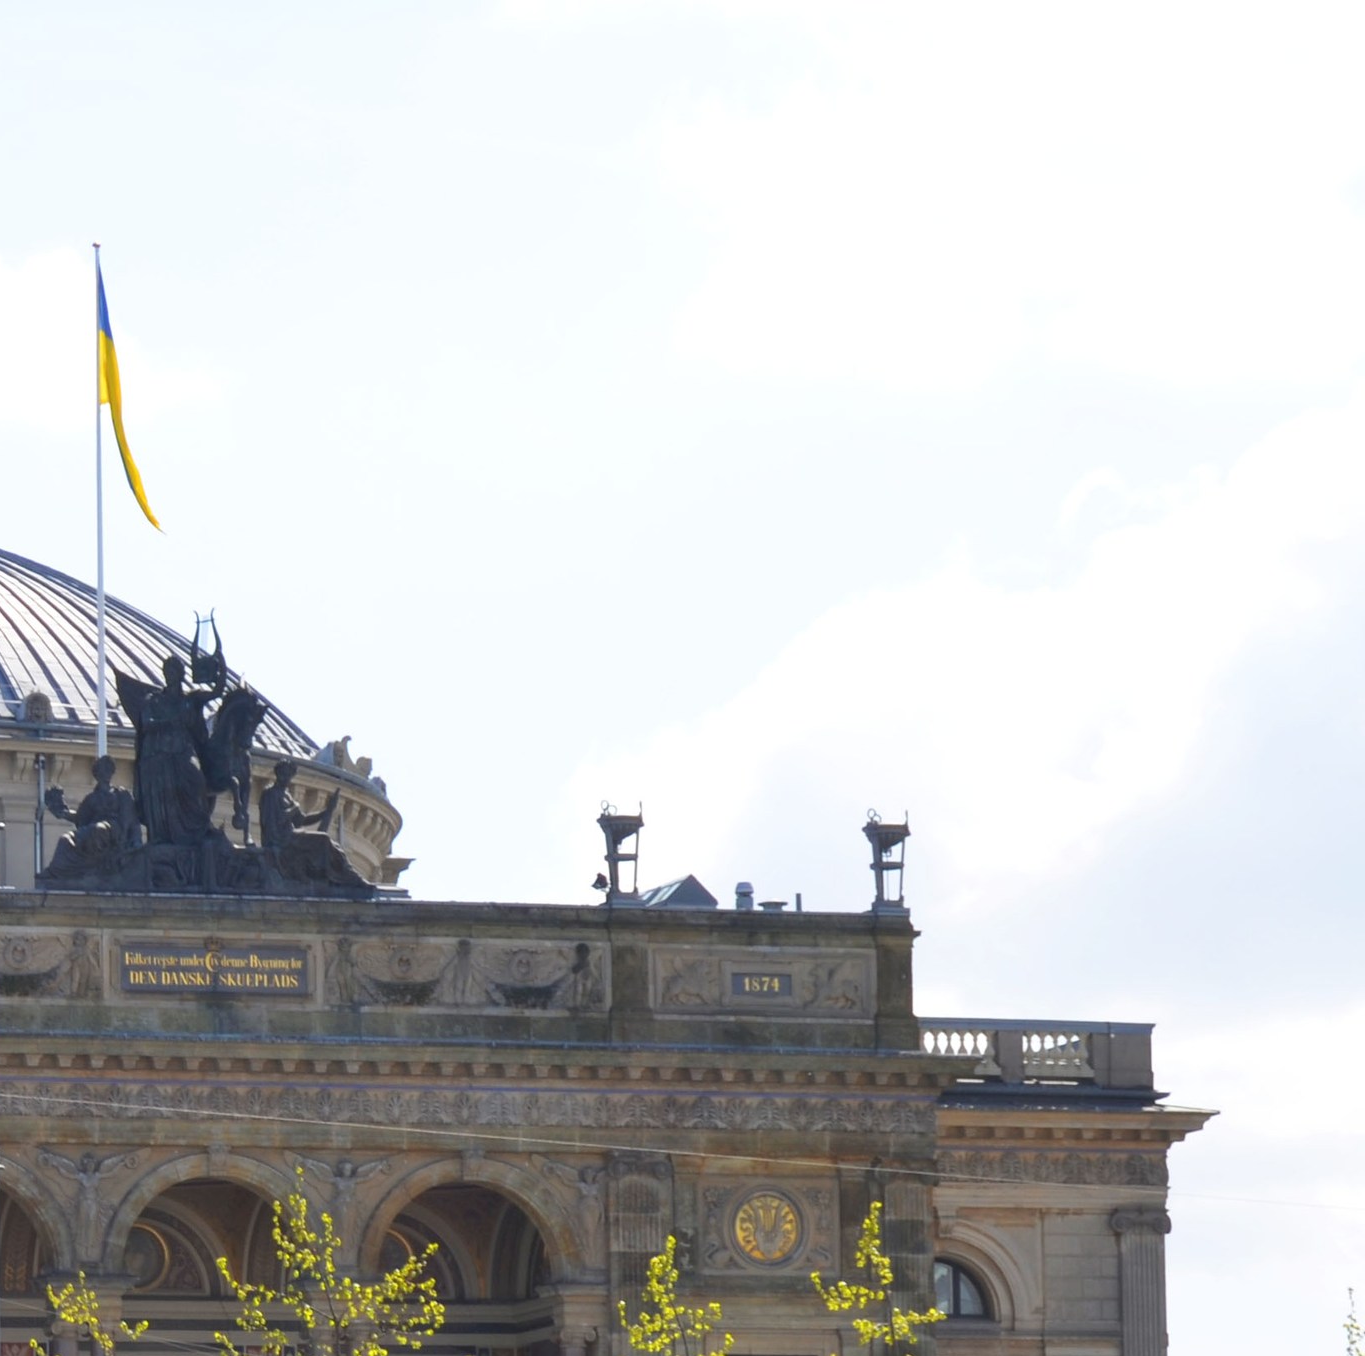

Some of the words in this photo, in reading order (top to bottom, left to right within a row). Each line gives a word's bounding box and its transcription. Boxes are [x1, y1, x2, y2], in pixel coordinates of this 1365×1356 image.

[221, 954, 248, 968] denne
[130, 970, 157, 985] DEN
[219, 972, 299, 988] SKUEPLADS
[744, 976, 780, 992] 1874
